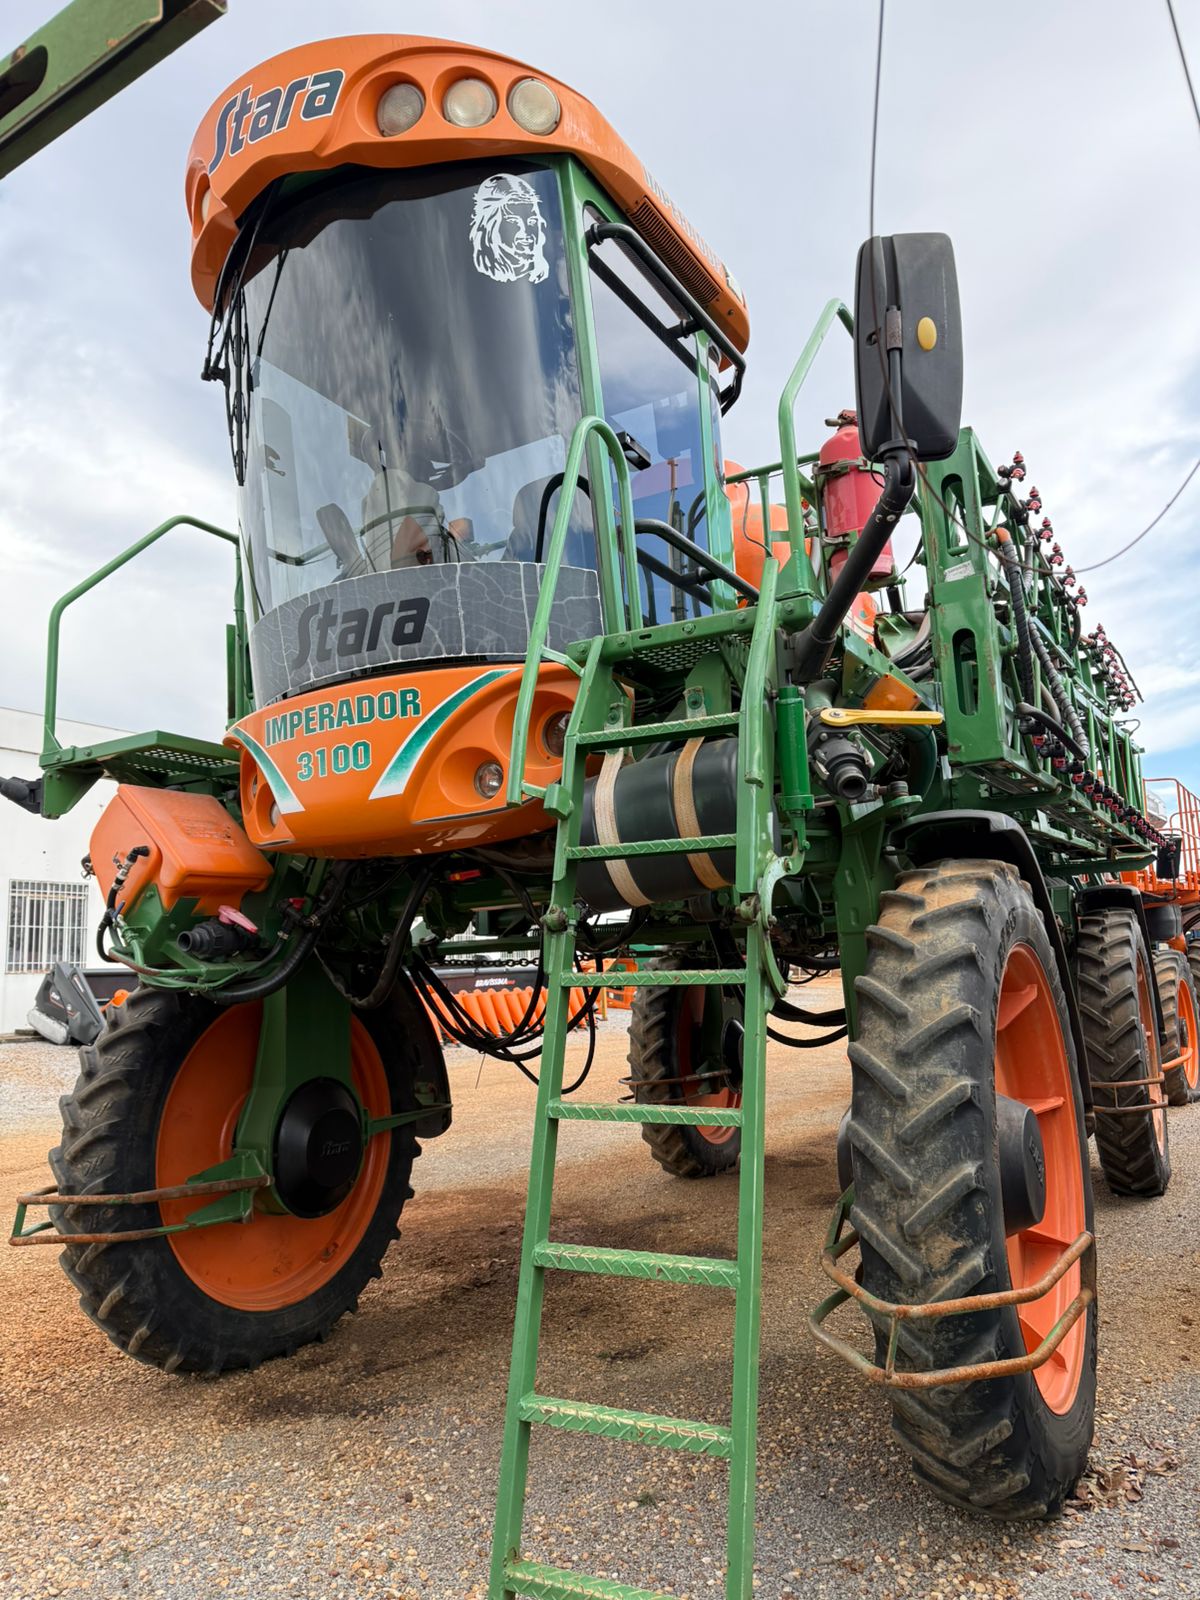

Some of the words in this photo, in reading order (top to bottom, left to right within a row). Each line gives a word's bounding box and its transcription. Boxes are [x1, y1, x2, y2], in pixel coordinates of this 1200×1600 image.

[208, 68, 346, 177] Stara
[291, 597, 431, 672] Stara
[265, 688, 421, 746] IMPERADOR
[298, 741, 371, 781] 3100
